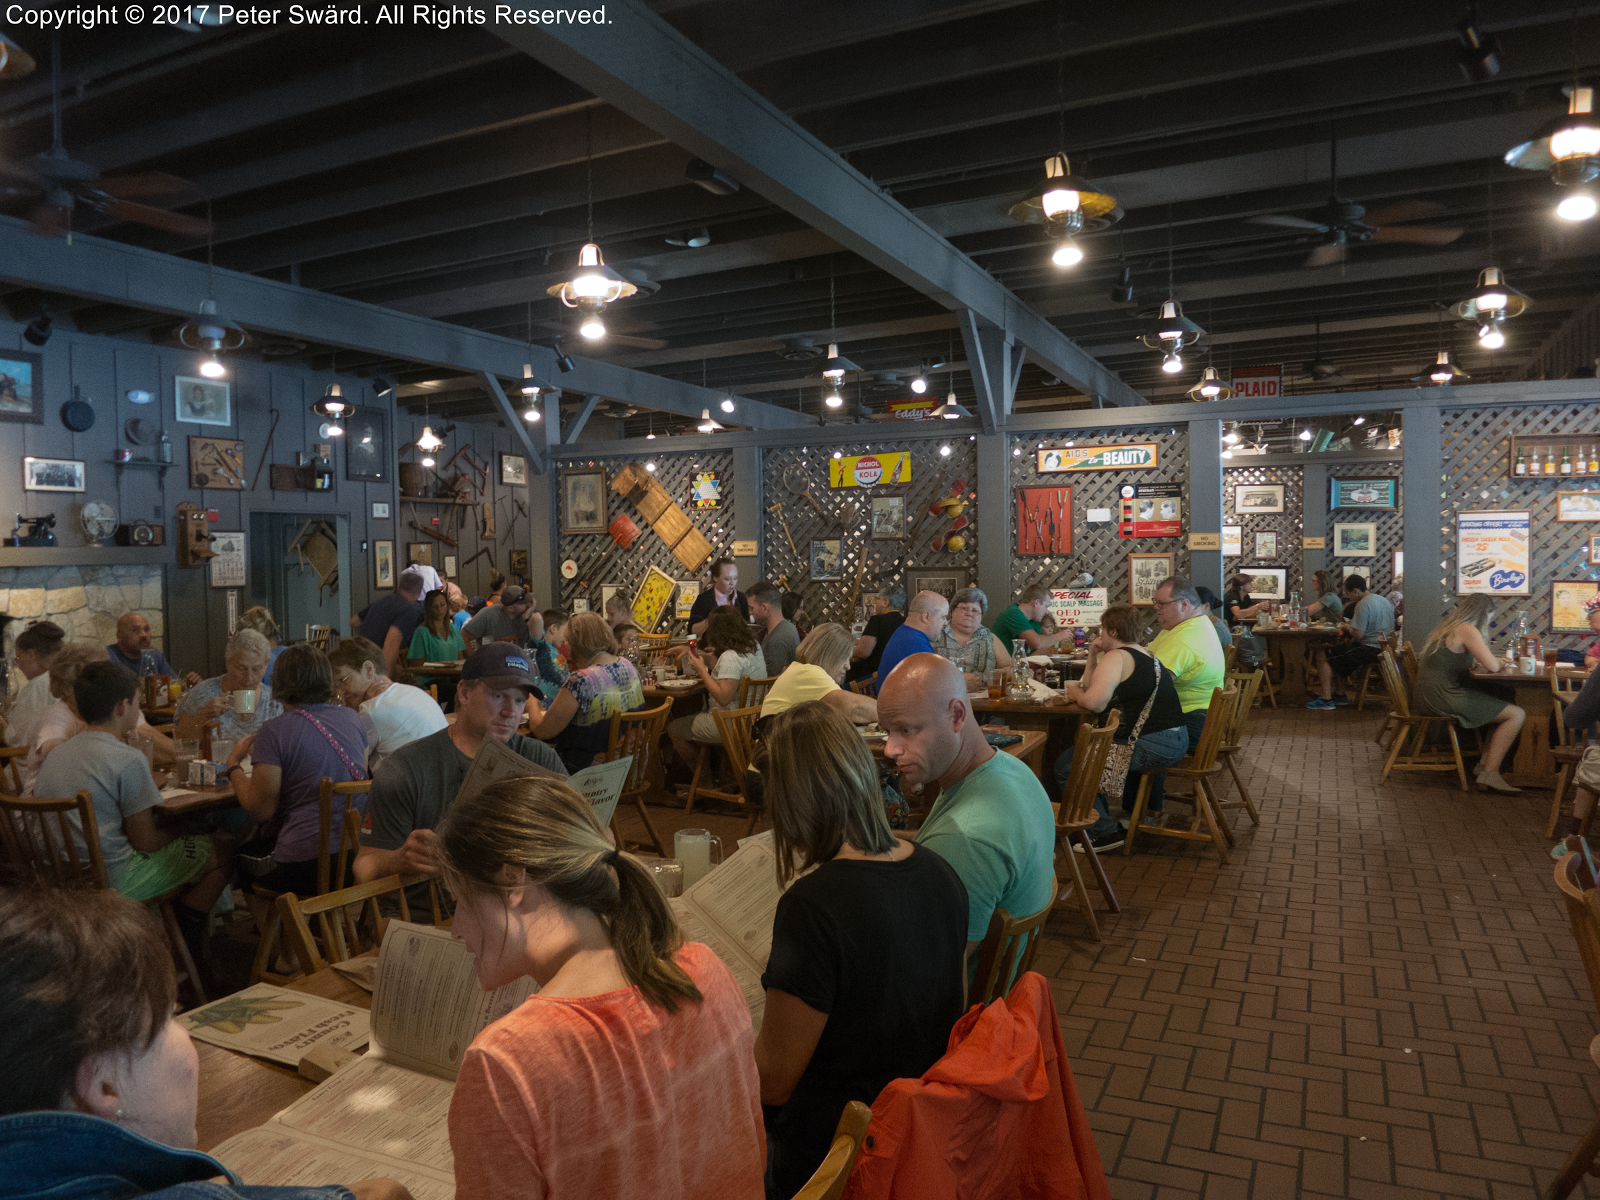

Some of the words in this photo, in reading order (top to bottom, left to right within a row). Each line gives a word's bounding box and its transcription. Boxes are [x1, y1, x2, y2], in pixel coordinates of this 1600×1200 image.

[1235, 380, 1277, 398] PLAID
[895, 407, 931, 420] Eddy's
[1065, 449, 1089, 459] AIDS
[1102, 450, 1147, 466] BEAUTY
[859, 471, 878, 479] KOLA
[1052, 590, 1094, 600] PECIAL
[315, 1010, 356, 1029] Fresh
[267, 1028, 317, 1051] Flavor
[294, 1020, 351, 1050] Country
